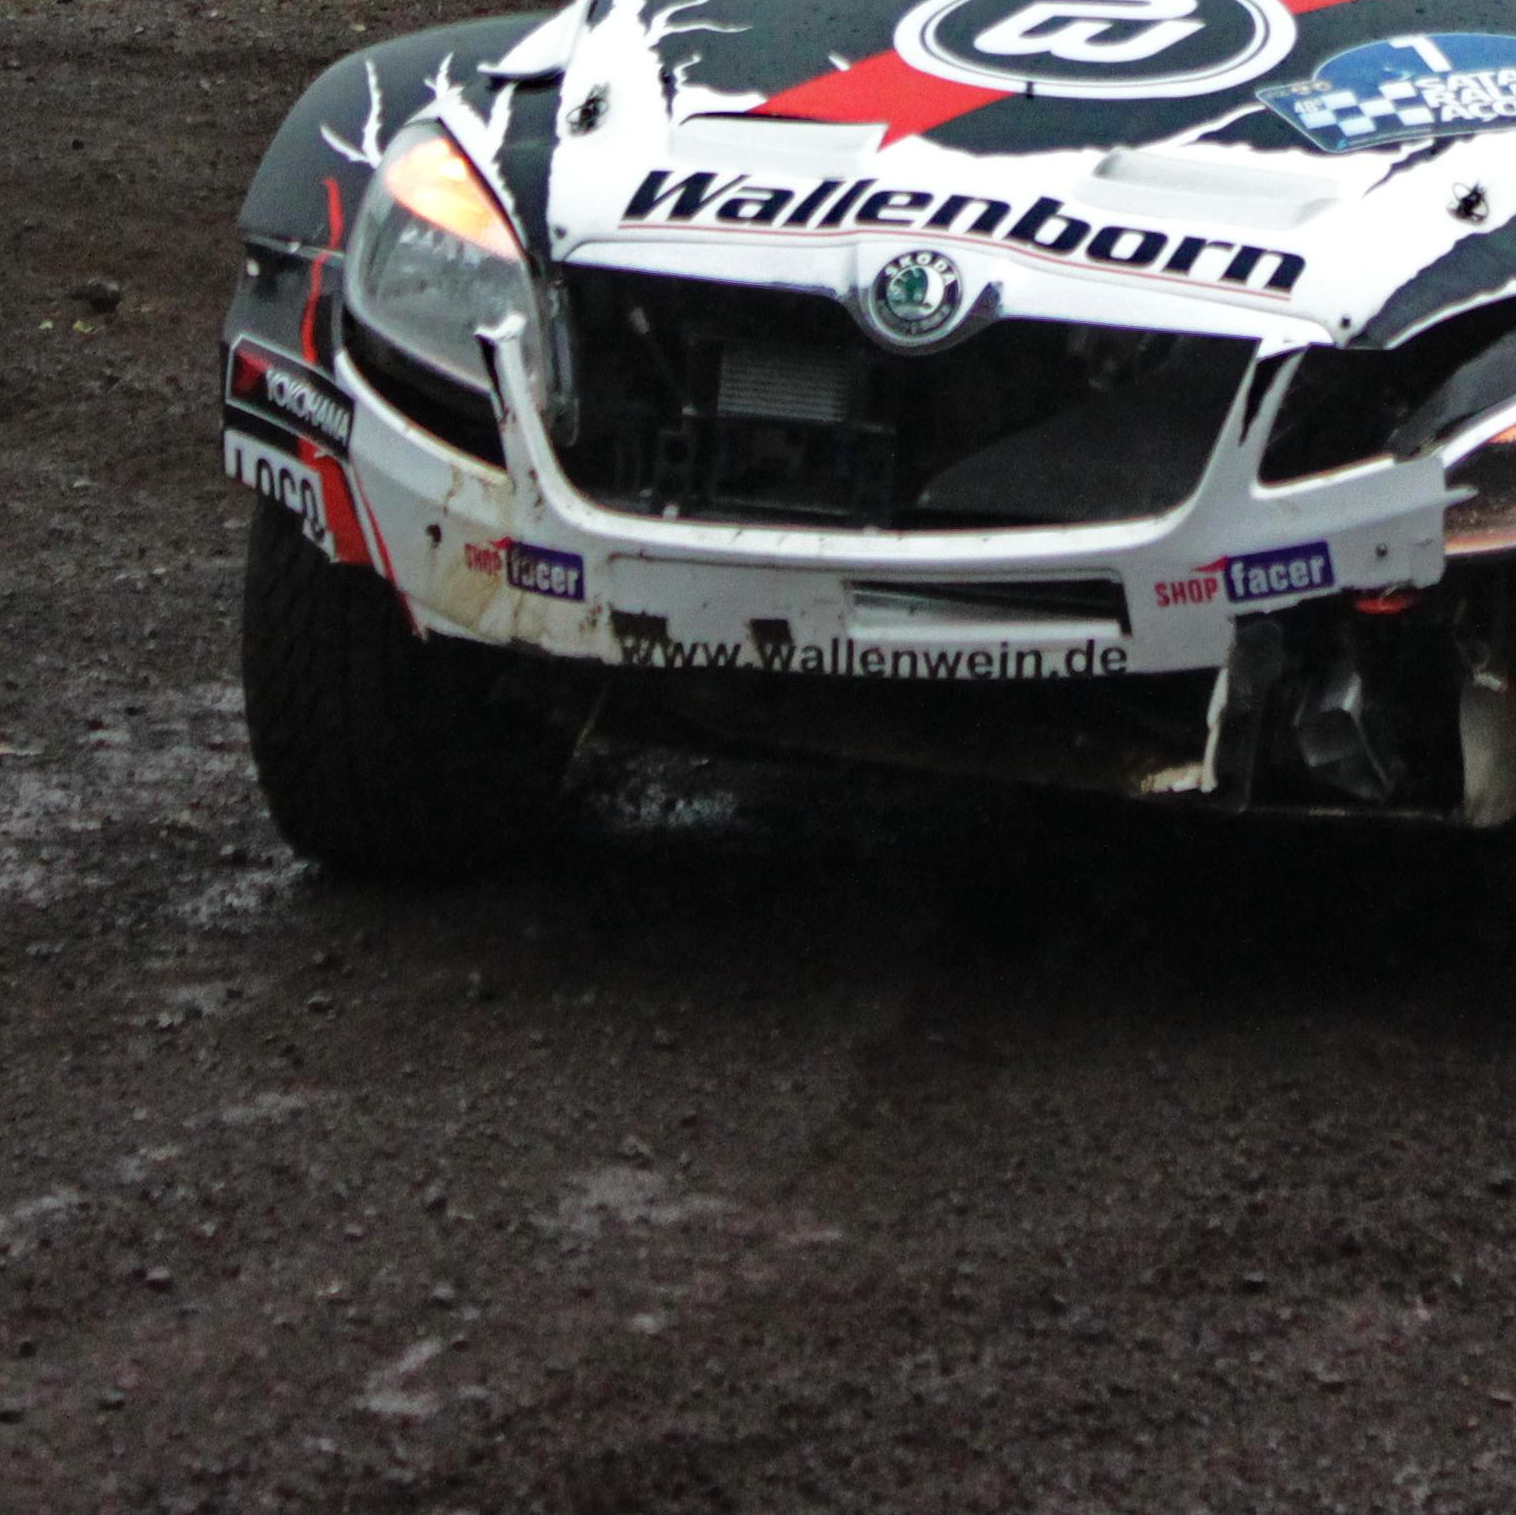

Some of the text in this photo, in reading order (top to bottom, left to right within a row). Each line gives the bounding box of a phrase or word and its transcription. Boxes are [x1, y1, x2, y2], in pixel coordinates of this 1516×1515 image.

[620, 169, 1308, 295] Wallenborn
[1154, 555, 1326, 608] SHOP facer
[615, 635, 1128, 679] www.wallenwein.de
